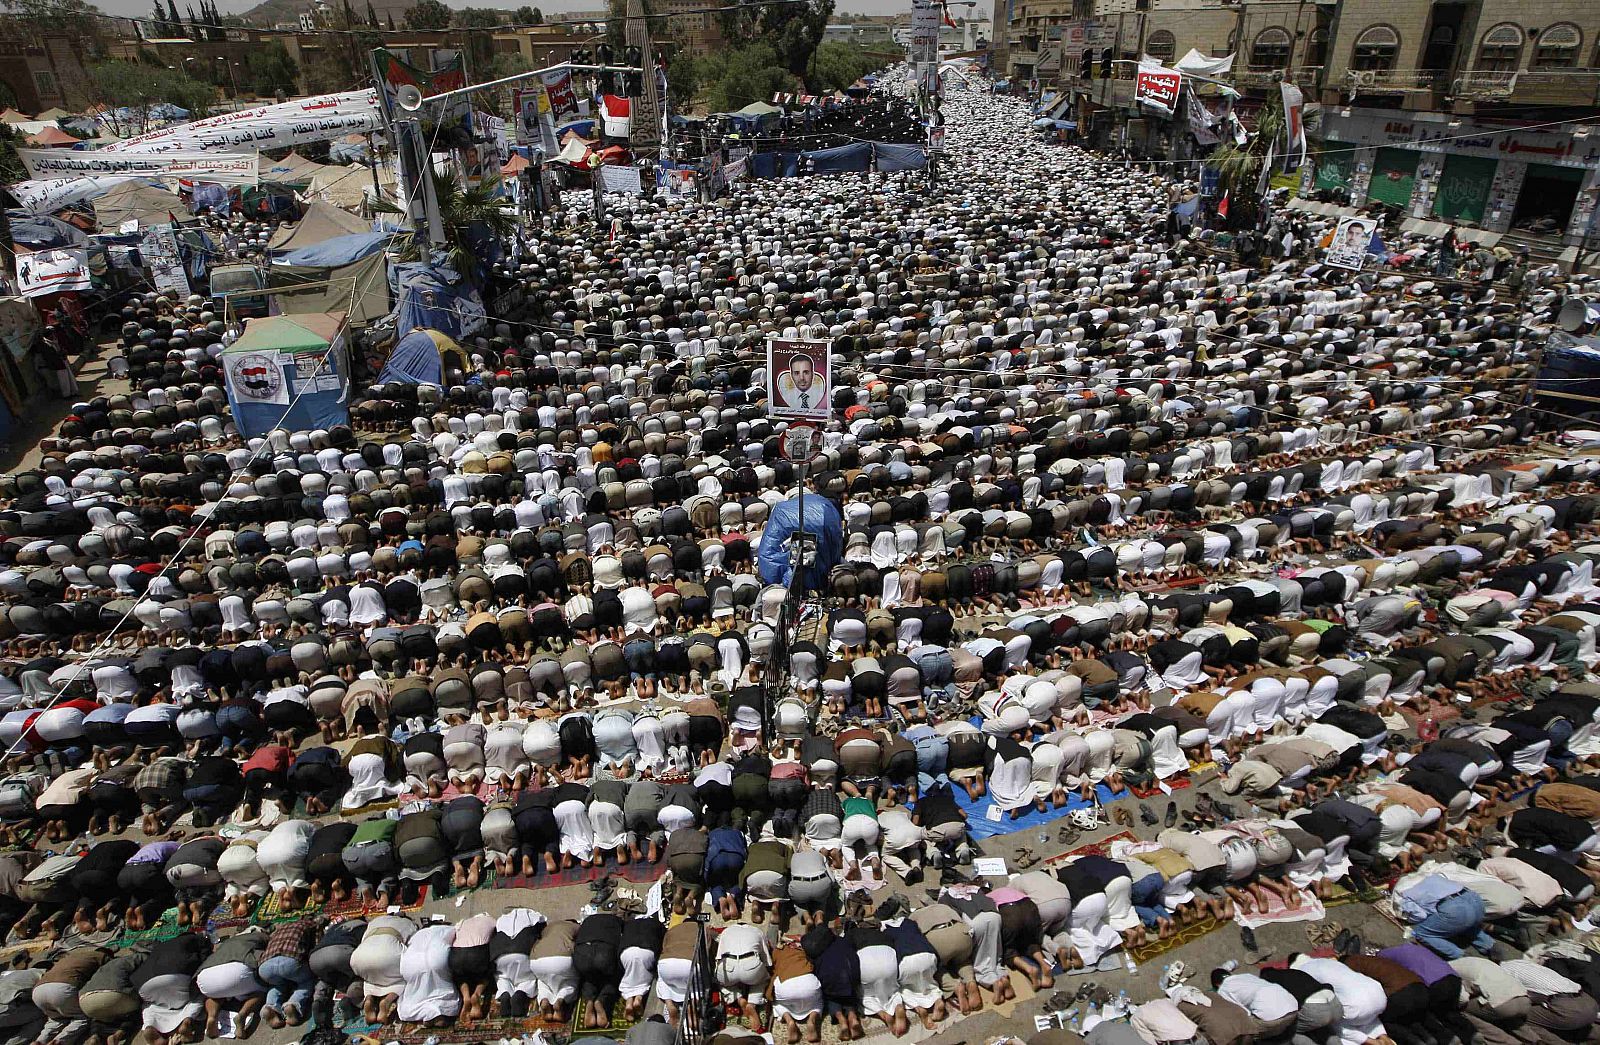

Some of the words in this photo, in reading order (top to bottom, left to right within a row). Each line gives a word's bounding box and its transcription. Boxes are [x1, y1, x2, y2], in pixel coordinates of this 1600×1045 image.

[1140, 84, 1174, 100] الثورة
[301, 96, 342, 112] الشعب
[229, 110, 254, 121] صنعاء
[346, 114, 365, 128] يريد
[188, 120, 208, 130] عدن
[292, 123, 318, 136] النظام
[254, 128, 276, 140] كلنا
[200, 135, 230, 150] اليمن
